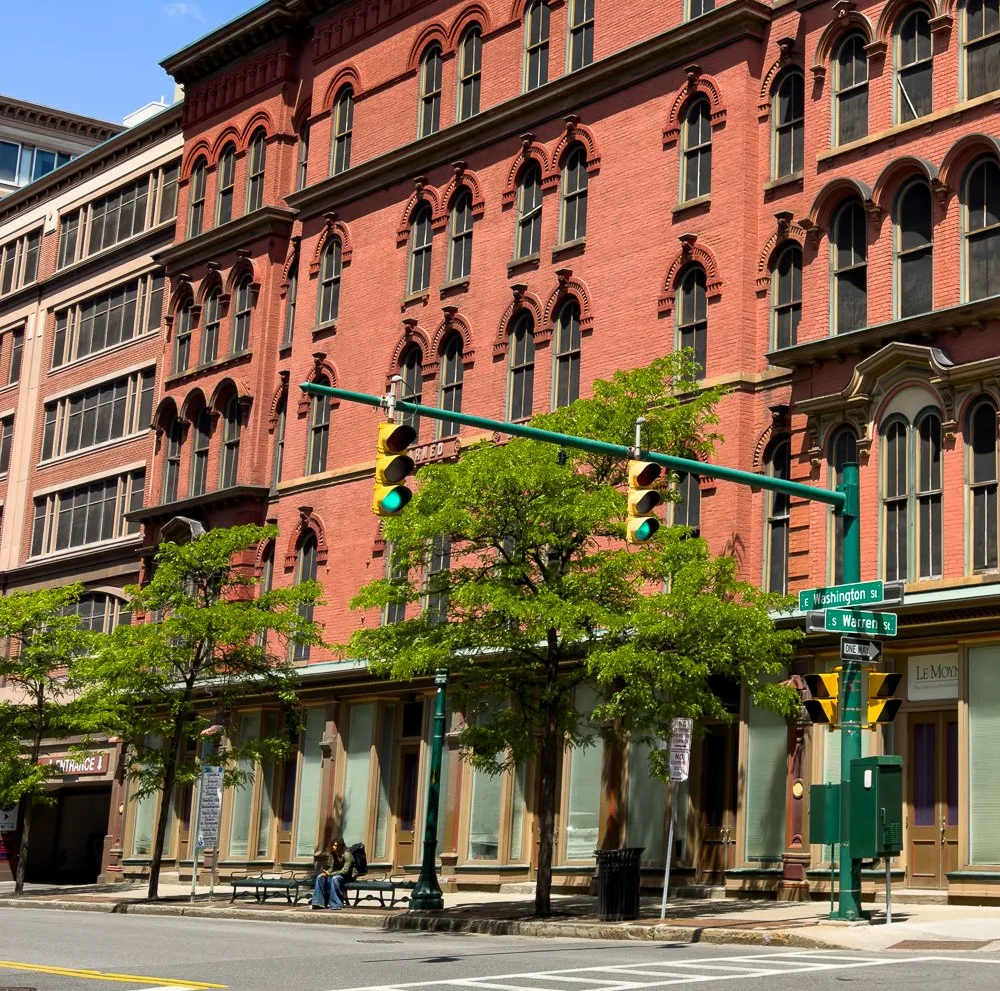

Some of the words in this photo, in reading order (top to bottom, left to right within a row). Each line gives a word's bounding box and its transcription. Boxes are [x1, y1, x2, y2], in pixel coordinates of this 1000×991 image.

[408, 442, 444, 462] RNED
[804, 598, 809, 606] E
[813, 588, 866, 605] Washington
[870, 589, 878, 599] St
[831, 617, 837, 626] S
[842, 614, 878, 629] Warren
[883, 621, 891, 630] St
[845, 644, 857, 654] ONE
[857, 645, 870, 655] WAY
